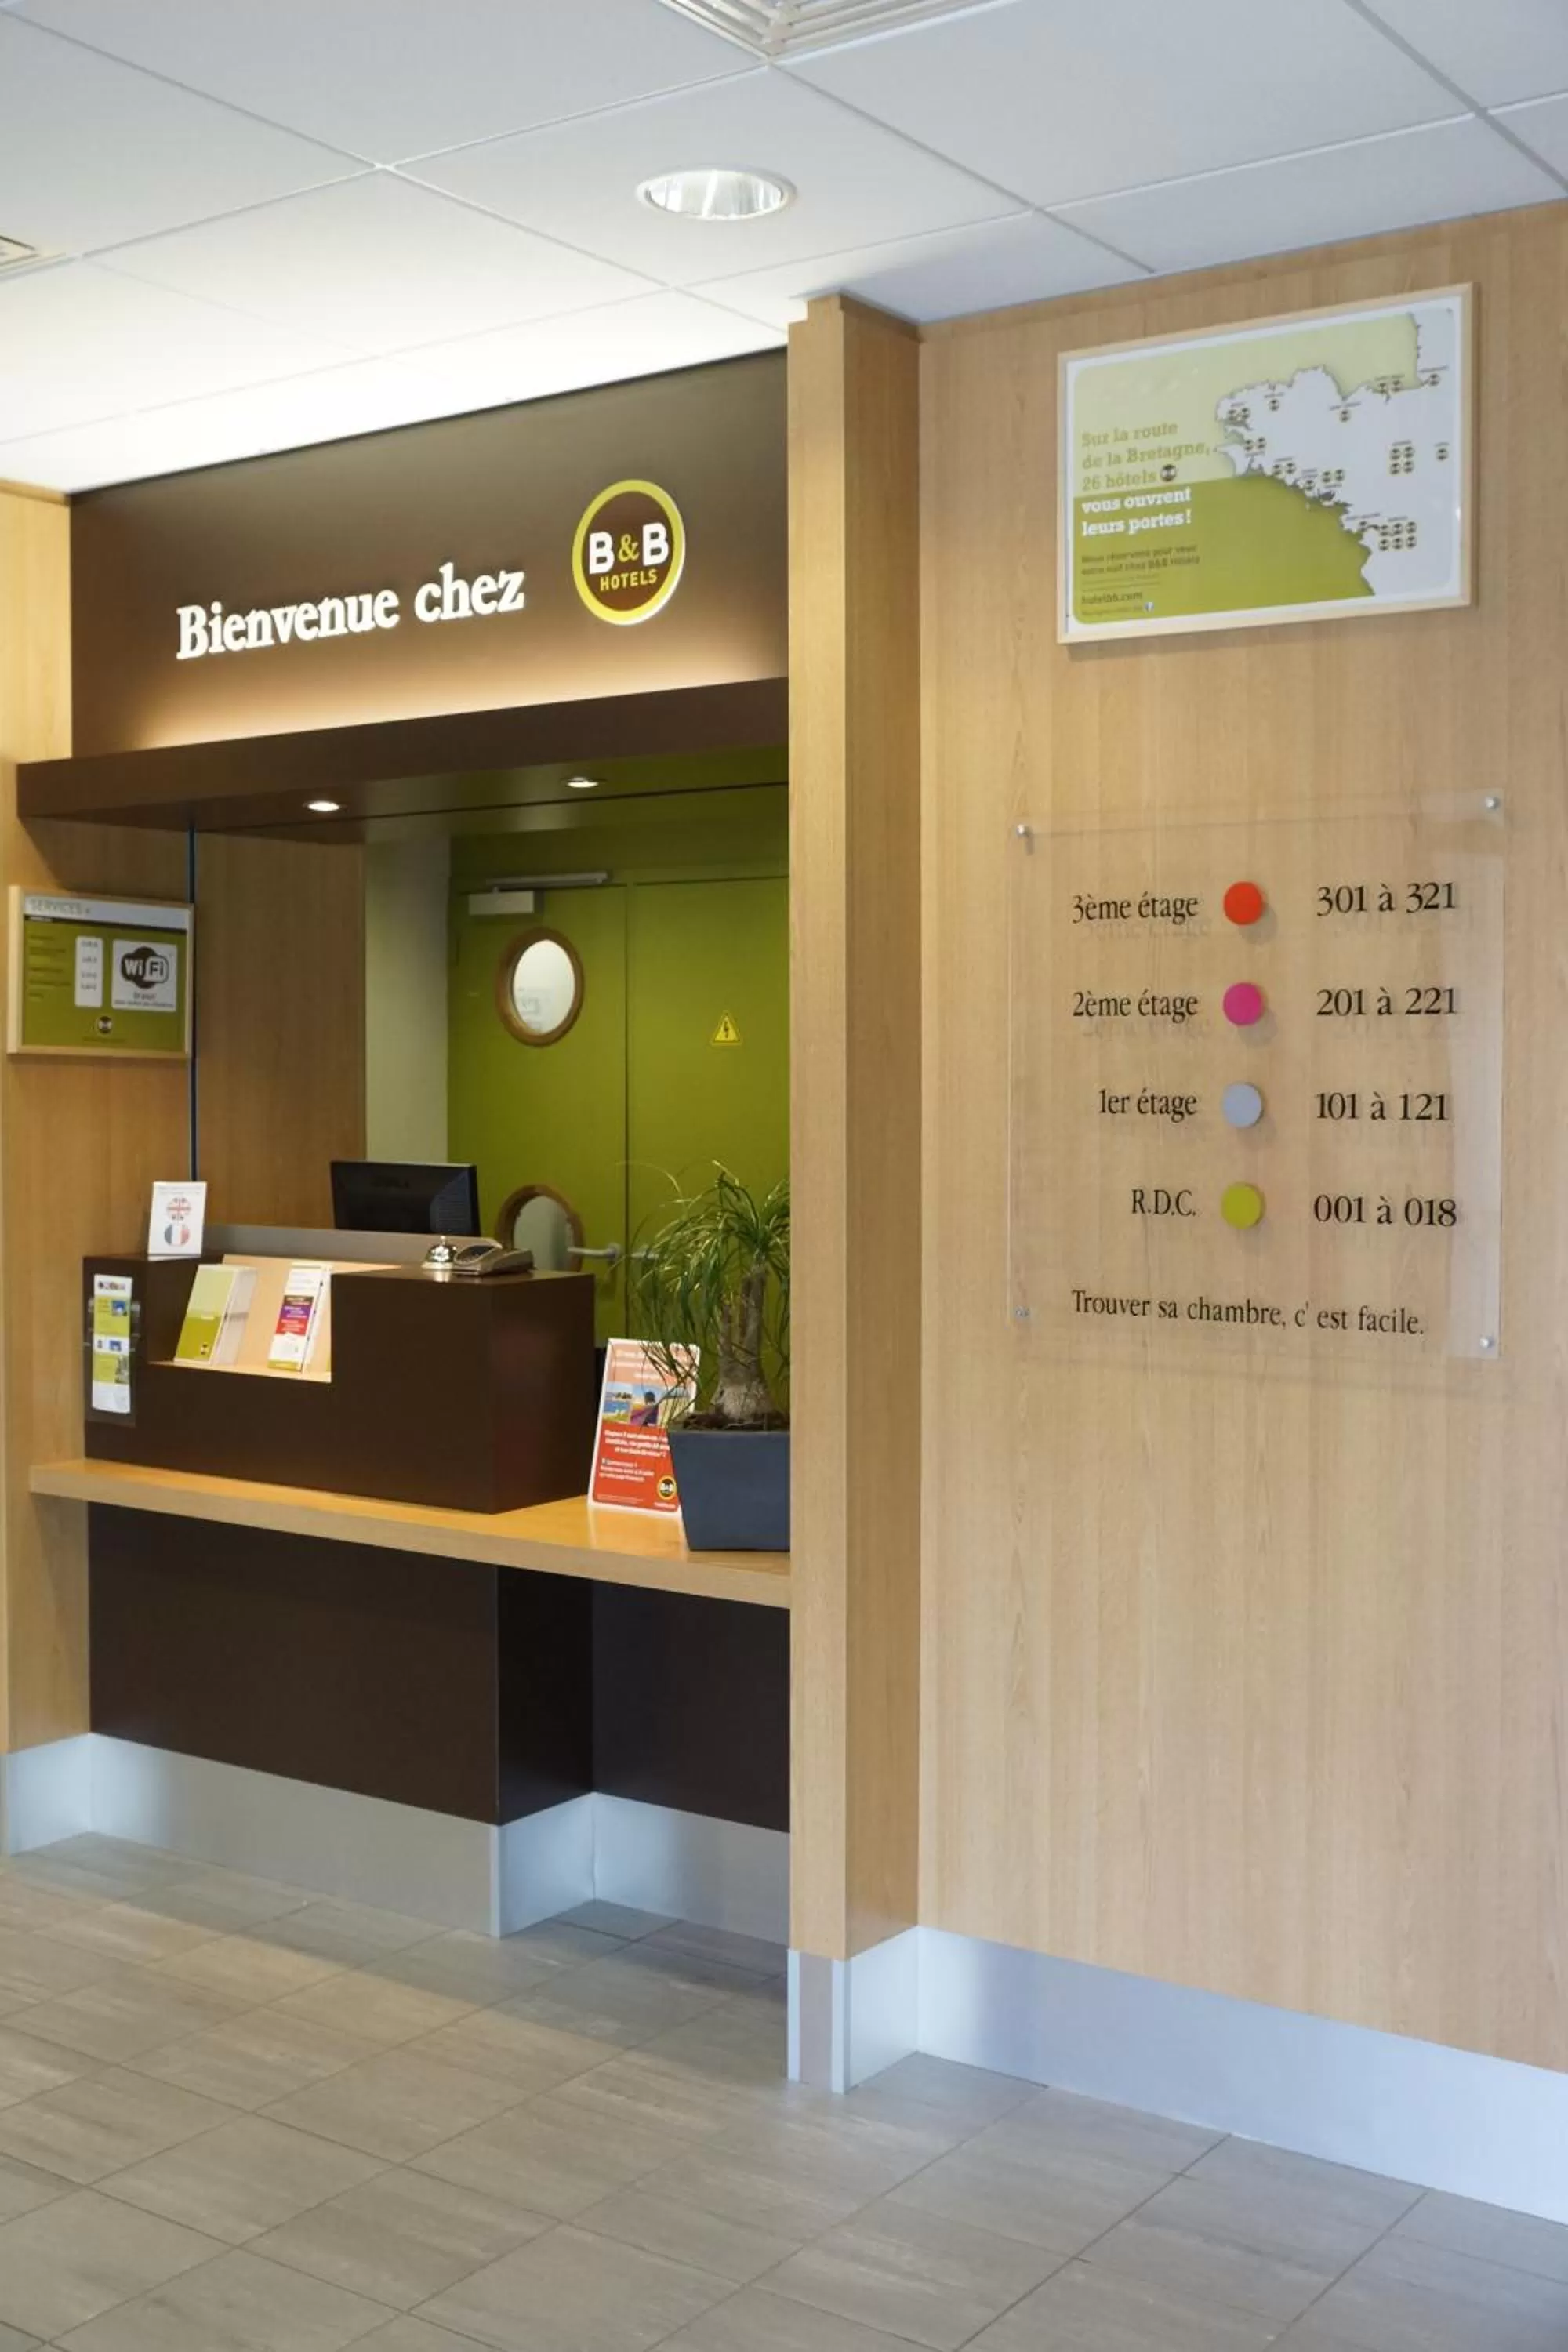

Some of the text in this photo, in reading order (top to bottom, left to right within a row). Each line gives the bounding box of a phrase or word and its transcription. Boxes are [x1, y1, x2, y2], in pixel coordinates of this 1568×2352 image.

[1082, 423, 1178, 447] Sur la route
[1082, 442, 1210, 469] de la Bretagne,
[1082, 486, 1192, 514] vous ouvrent
[1082, 521, 1125, 536] leurs
[589, 522, 669, 574] B&B
[600, 569, 657, 592] HOTELS
[176, 562, 525, 659] Bienvenue chez
[1072, 882, 1456, 924] 3ème étage 301 à 321
[1073, 987, 1457, 1022] 2ème étage 201 à 221
[1137, 1087, 1197, 1123] étage
[1316, 1092, 1359, 1120] 101
[1370, 1091, 1387, 1120] à
[1399, 1093, 1450, 1121] 121
[1131, 1189, 1457, 1227] R.D.C. 001 à 018
[1073, 1290, 1151, 1317] Trouver
[1158, 1301, 1178, 1319] sa
[1188, 1296, 1287, 1327] chambre,
[1359, 1305, 1424, 1334] facile.
